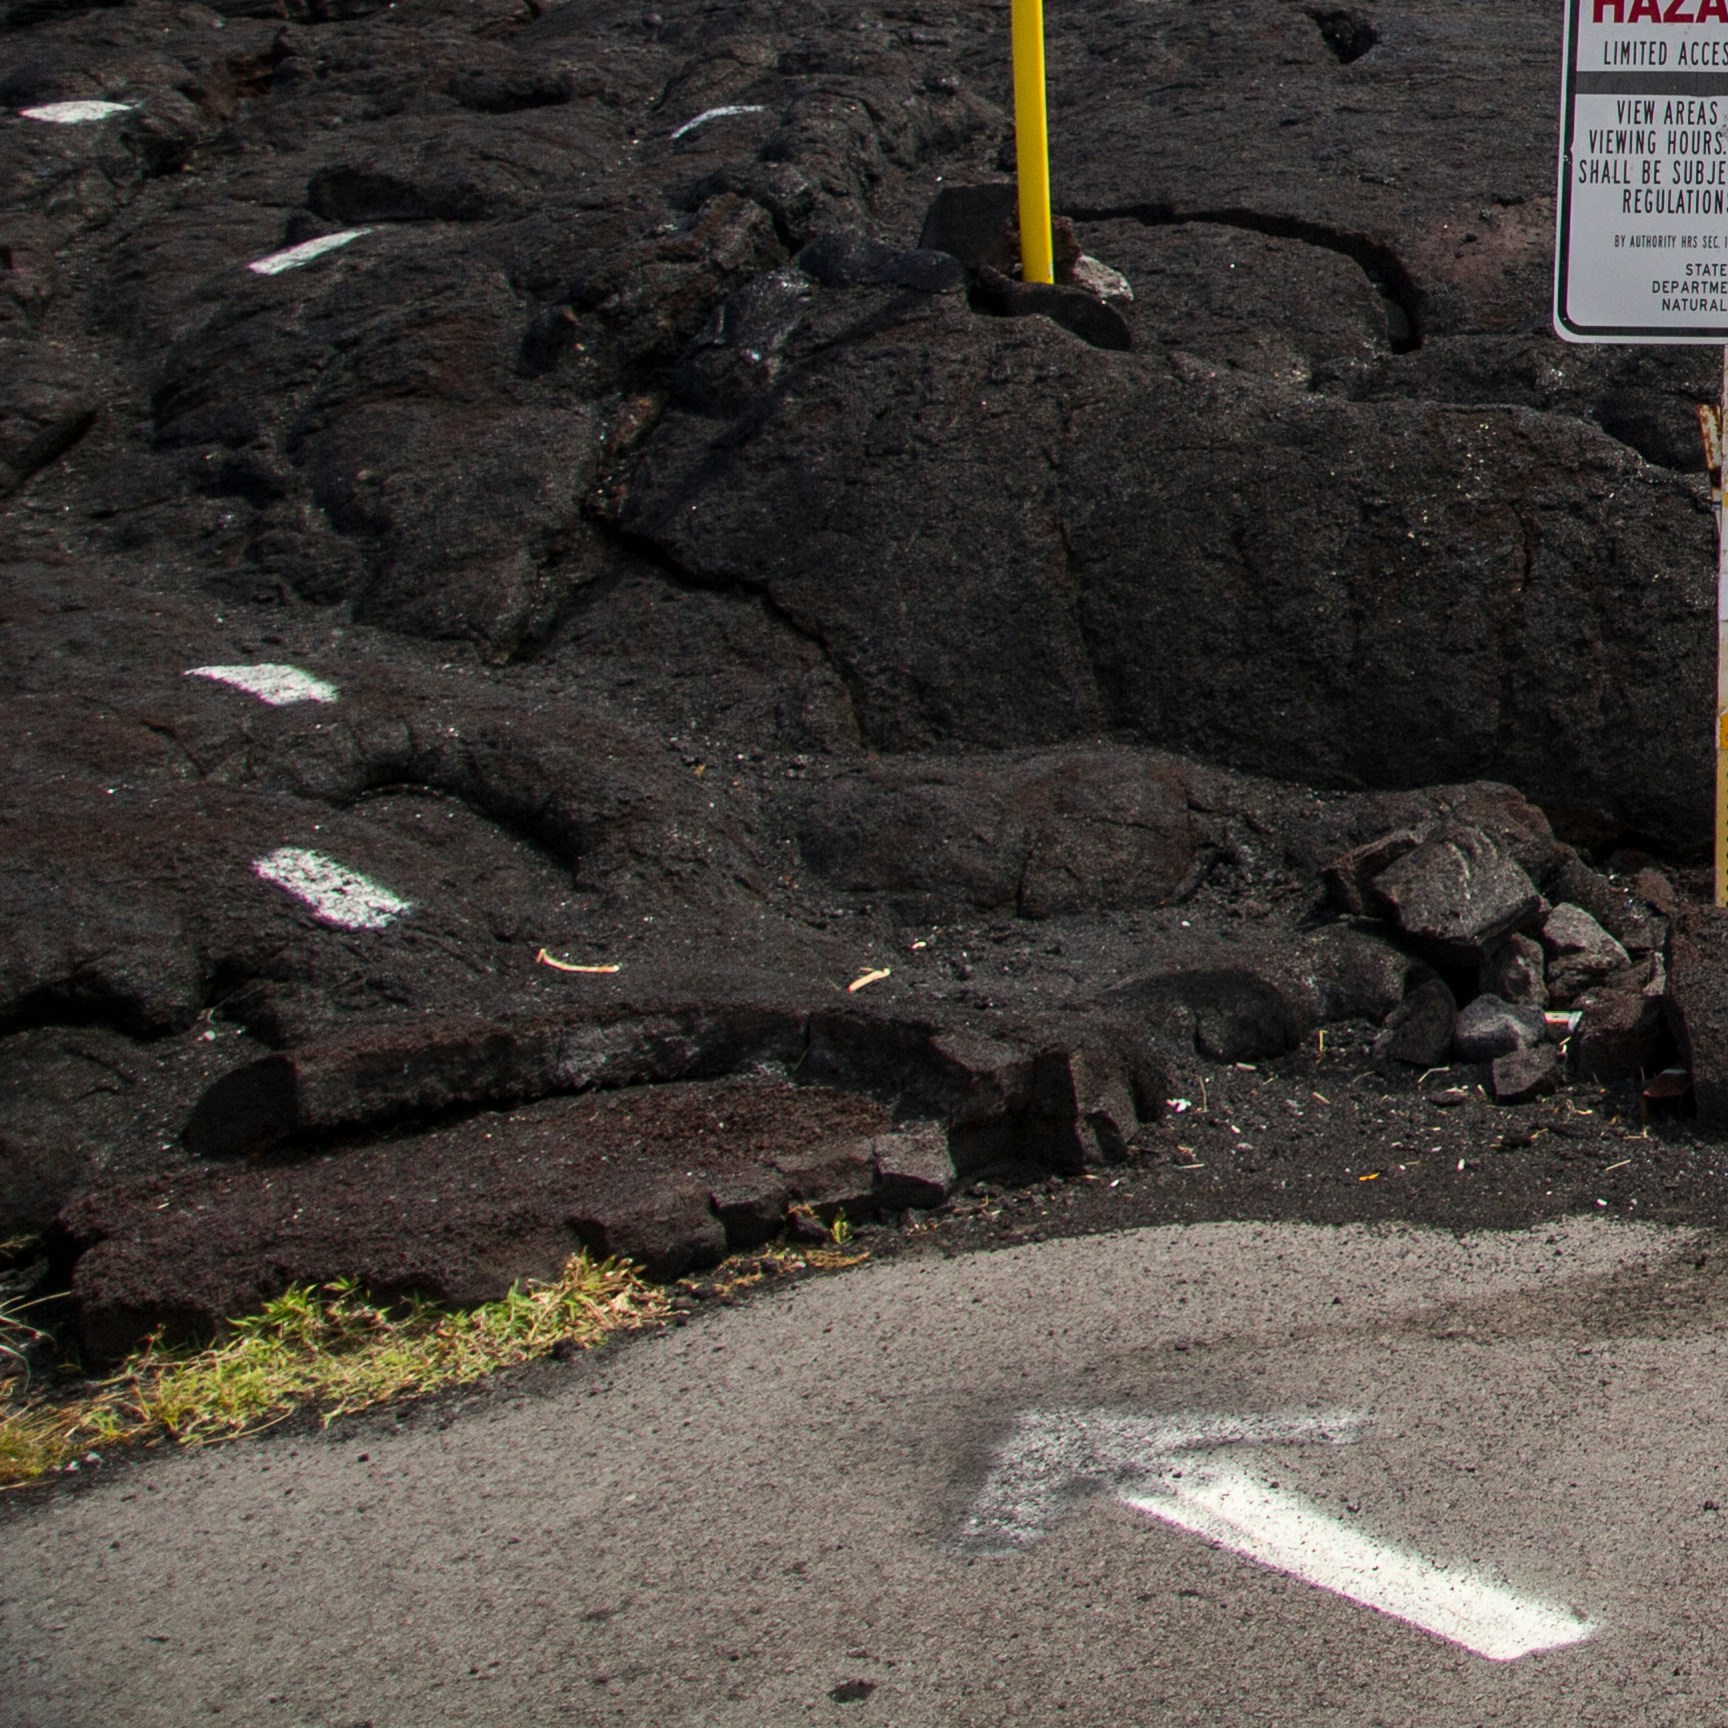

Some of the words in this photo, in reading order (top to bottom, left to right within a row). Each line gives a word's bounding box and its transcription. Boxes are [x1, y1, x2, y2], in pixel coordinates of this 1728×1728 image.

[1604, 40, 1667, 65] LIMITED
[1617, 100, 1655, 125] VIEW
[1664, 101, 1718, 125] AREAS
[1589, 130, 1656, 154] VIEWING
[1667, 130, 1727, 155] HOURS.
[1579, 160, 1630, 184] SHALL
[1642, 160, 1661, 184] BE
[1614, 235, 1626, 247] BY
[1629, 235, 1676, 248] AUTHORITY
[1681, 235, 1697, 248] HRS
[1702, 235, 1721, 248] SEC.
[1685, 263, 1727, 276] STATE
[1661, 298, 1727, 311] NATURAL
